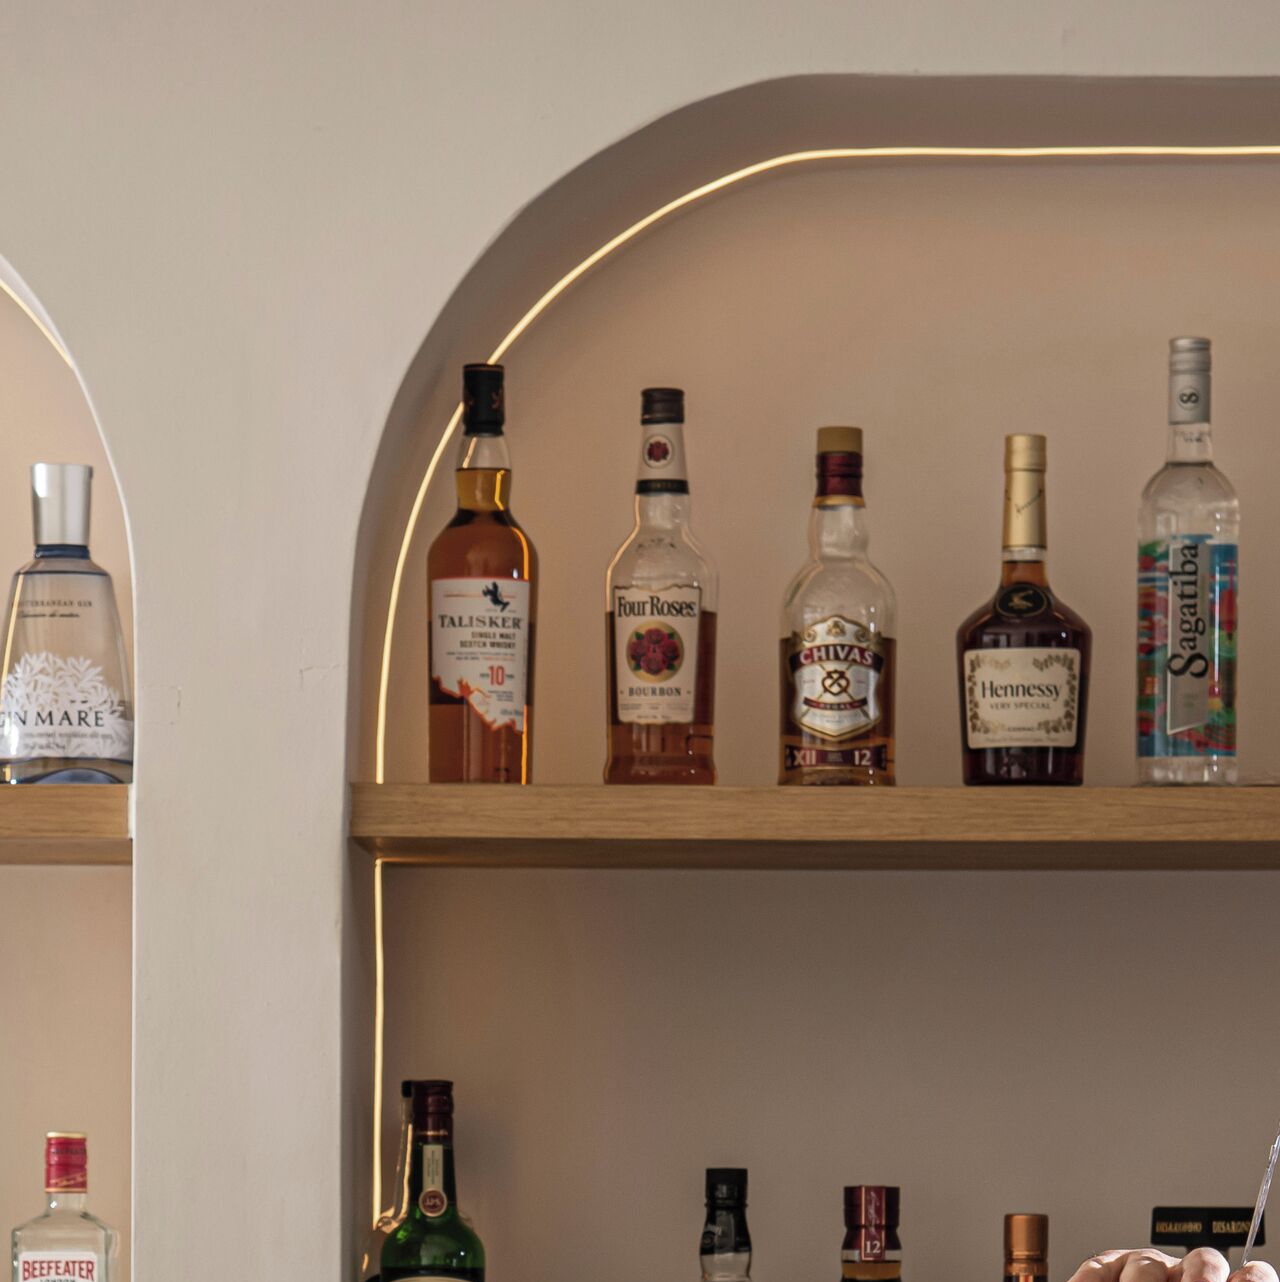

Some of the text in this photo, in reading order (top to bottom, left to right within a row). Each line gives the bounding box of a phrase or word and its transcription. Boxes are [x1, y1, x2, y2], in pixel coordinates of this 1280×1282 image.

[617, 595, 697, 618] Four Roses
[1166, 542, 1210, 679] Sagatiba
[438, 614, 522, 630] TALISKER
[800, 646, 874, 665] CHIVAS
[488, 665, 505, 686] 10
[628, 687, 682, 697] BOURBON
[981, 681, 1060, 702] Hennessy
[35, 710, 105, 728] MARE
[854, 750, 872, 765] 12
[865, 1240, 881, 1254] 12
[22, 1260, 95, 1282] BEEFEATER
